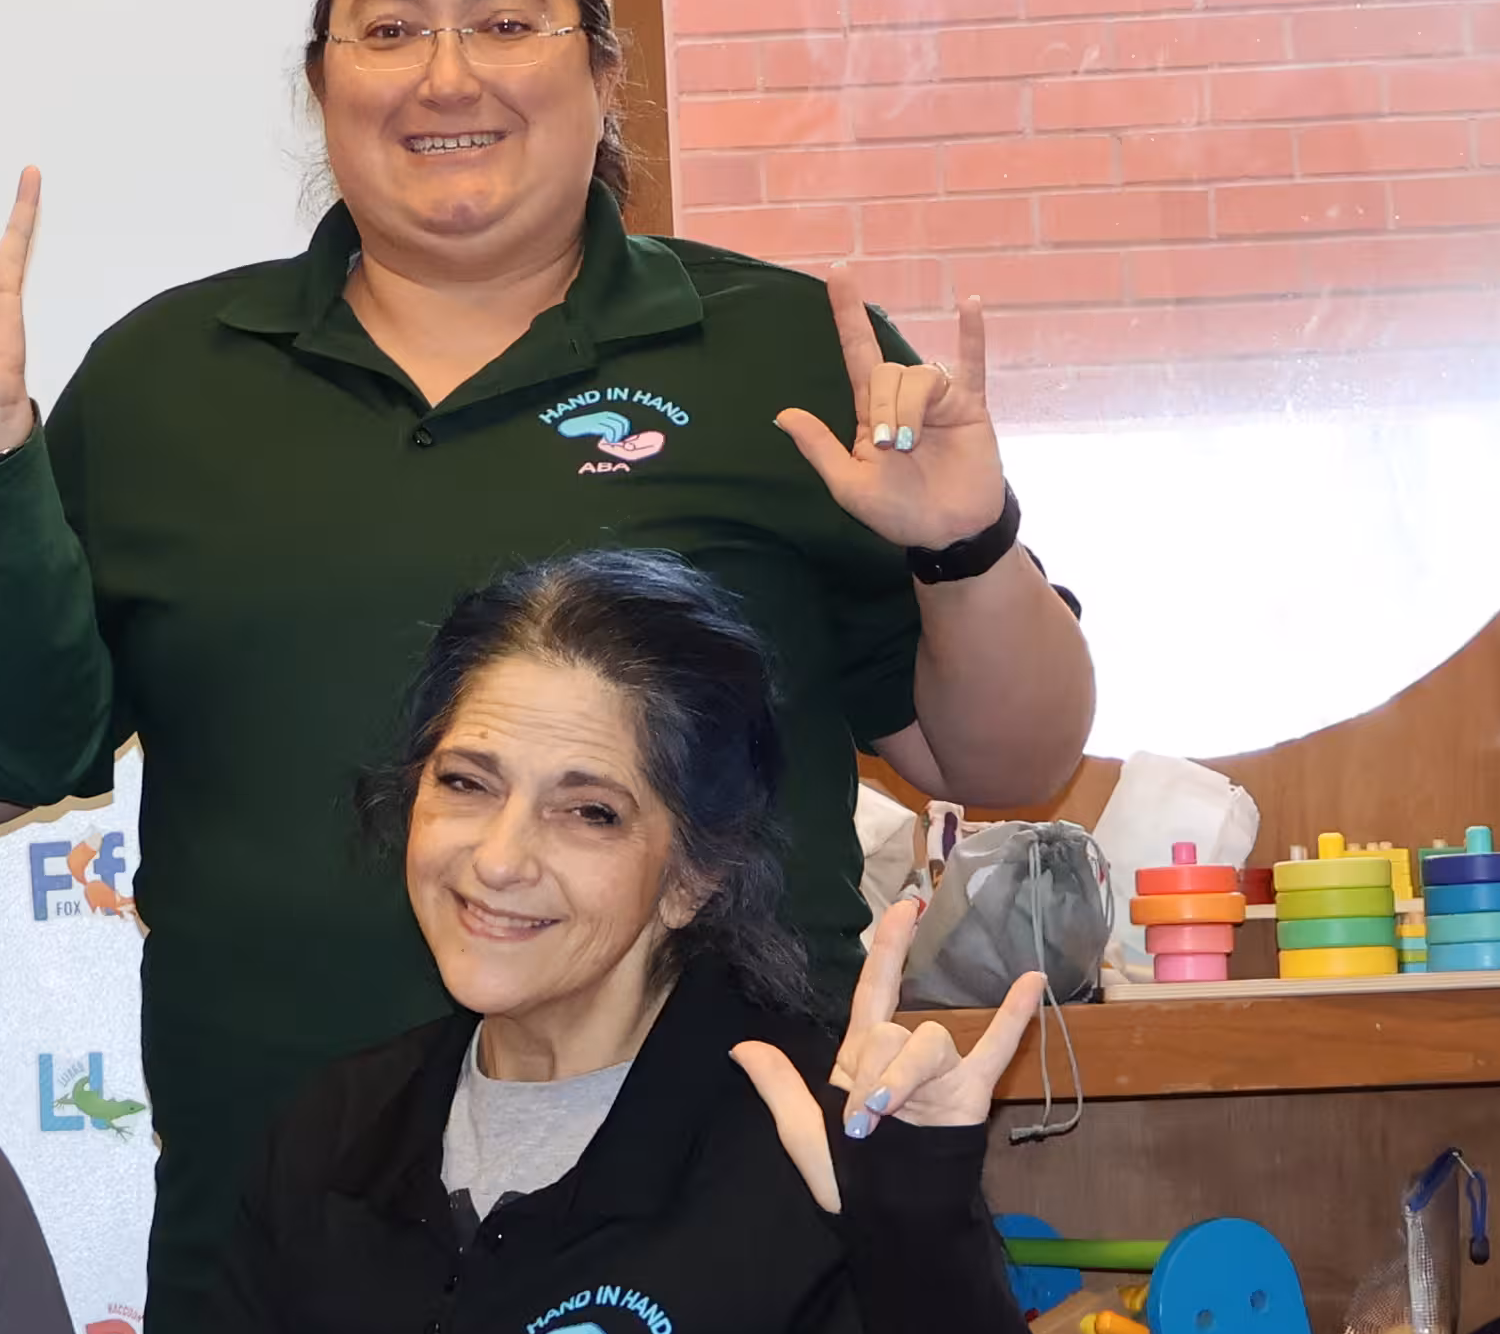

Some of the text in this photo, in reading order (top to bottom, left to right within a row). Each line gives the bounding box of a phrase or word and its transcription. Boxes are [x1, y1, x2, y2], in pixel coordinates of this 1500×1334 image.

[538, 387, 690, 426] HAND IN HAND
[578, 462, 631, 474] ABA
[56, 900, 82, 917] FOX
[595, 1285, 621, 1306] IN
